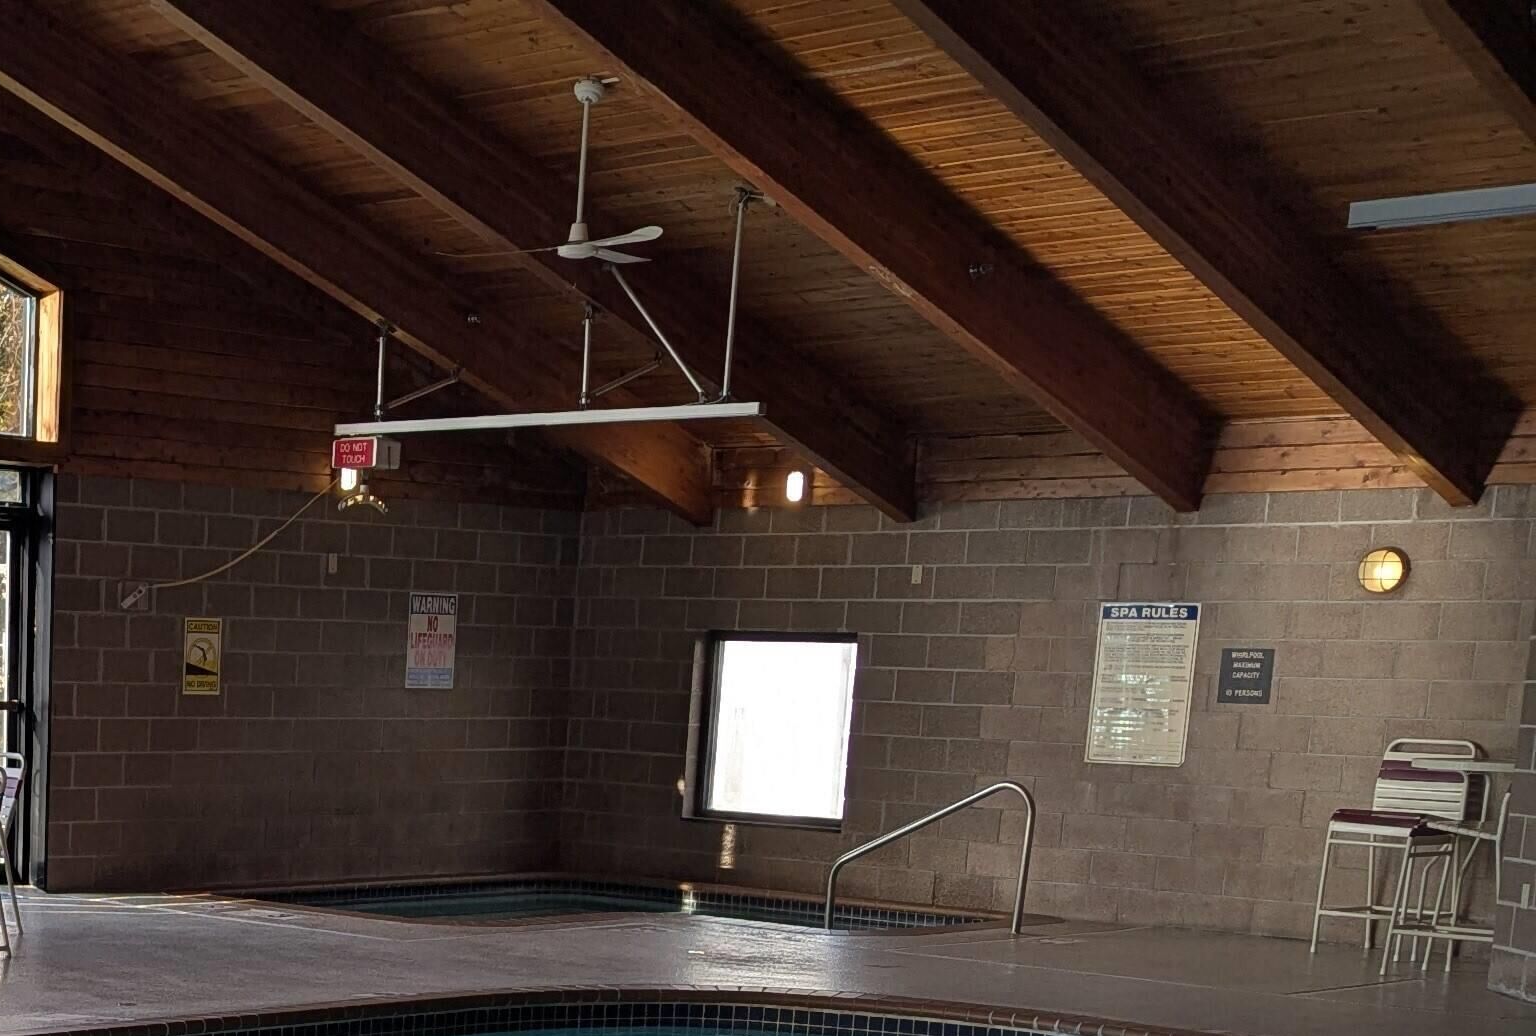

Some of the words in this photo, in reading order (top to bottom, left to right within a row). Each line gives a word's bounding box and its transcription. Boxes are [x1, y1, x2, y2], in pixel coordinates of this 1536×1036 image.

[339, 443, 351, 453] DO
[352, 442, 368, 452] NOT
[342, 454, 366, 464] TOUCH
[412, 595, 456, 615] WARNING
[1110, 607, 1138, 618] SPA
[1141, 607, 1189, 618] RULES
[427, 615, 439, 632] NO
[410, 632, 453, 649] LIFEGUARD
[1232, 671, 1261, 679] CAPACITY
